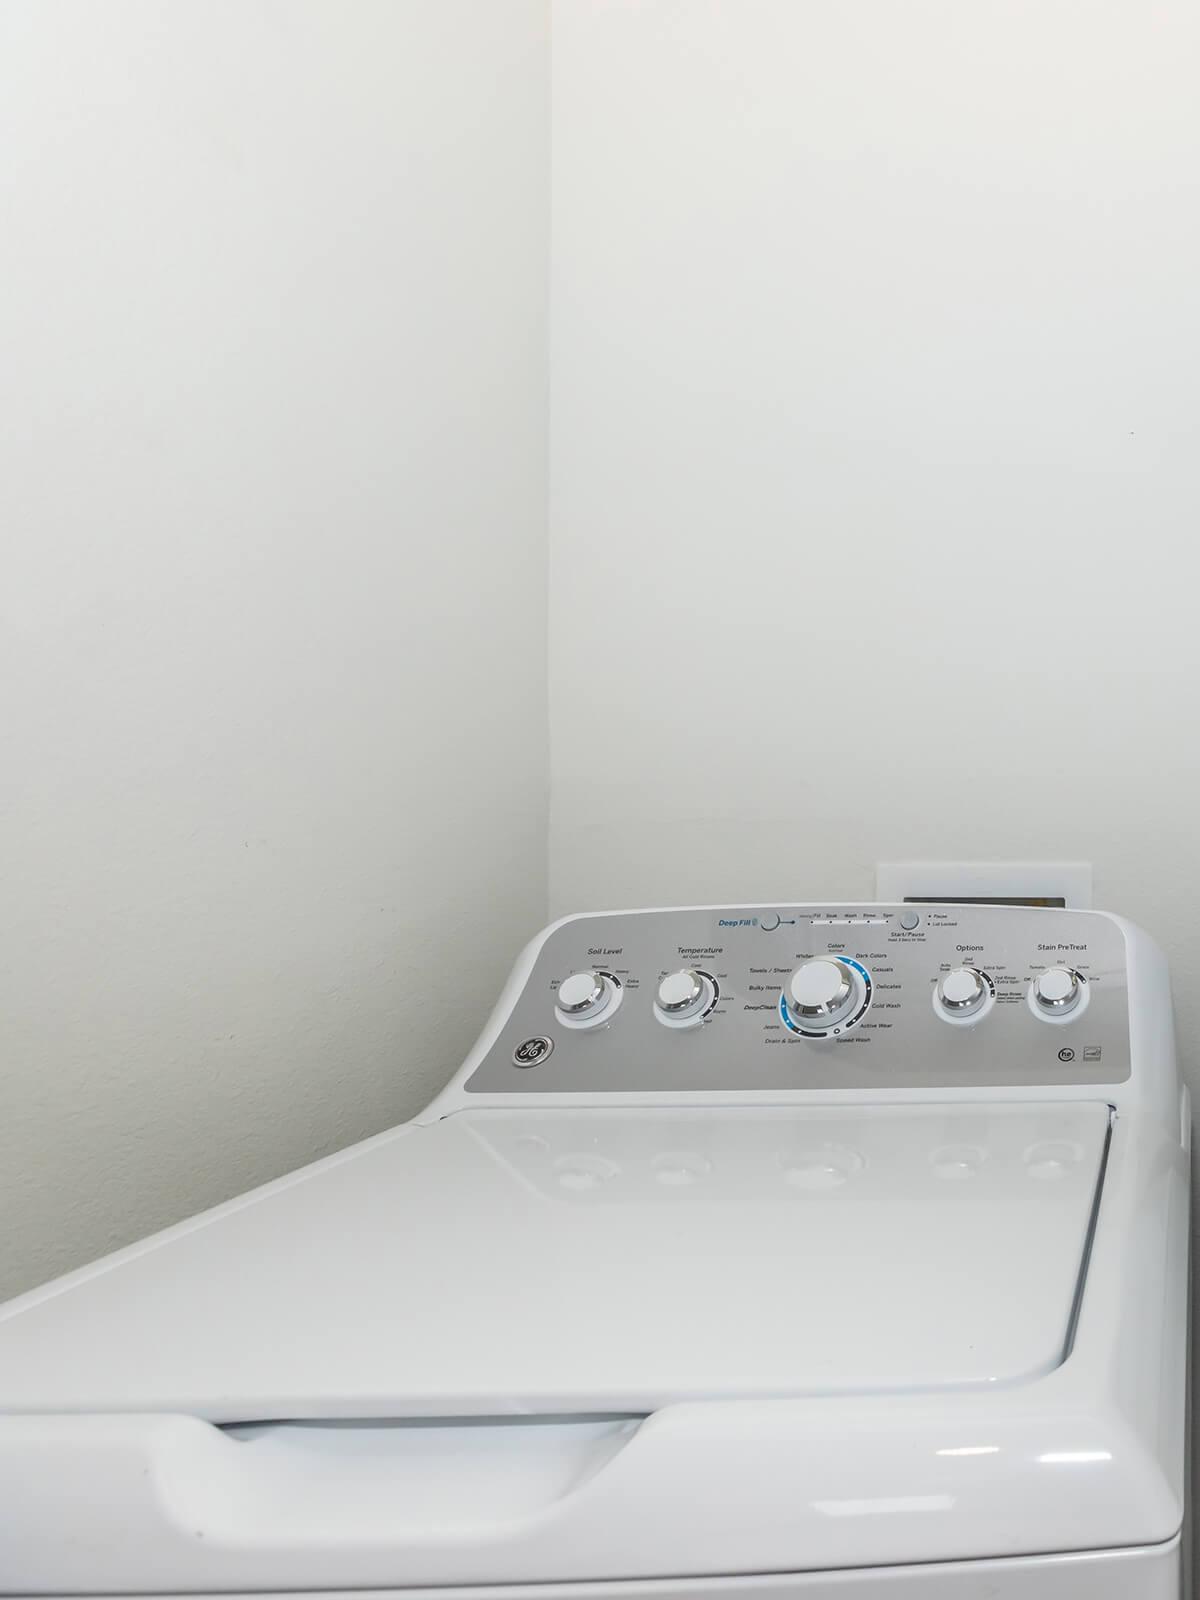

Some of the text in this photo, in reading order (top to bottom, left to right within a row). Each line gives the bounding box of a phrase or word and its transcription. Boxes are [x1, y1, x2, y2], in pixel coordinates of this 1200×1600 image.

[718, 919, 739, 927] Deep
[678, 947, 723, 955] Temperature
[955, 944, 985, 952] Options
[1037, 943, 1057, 951] Stain
